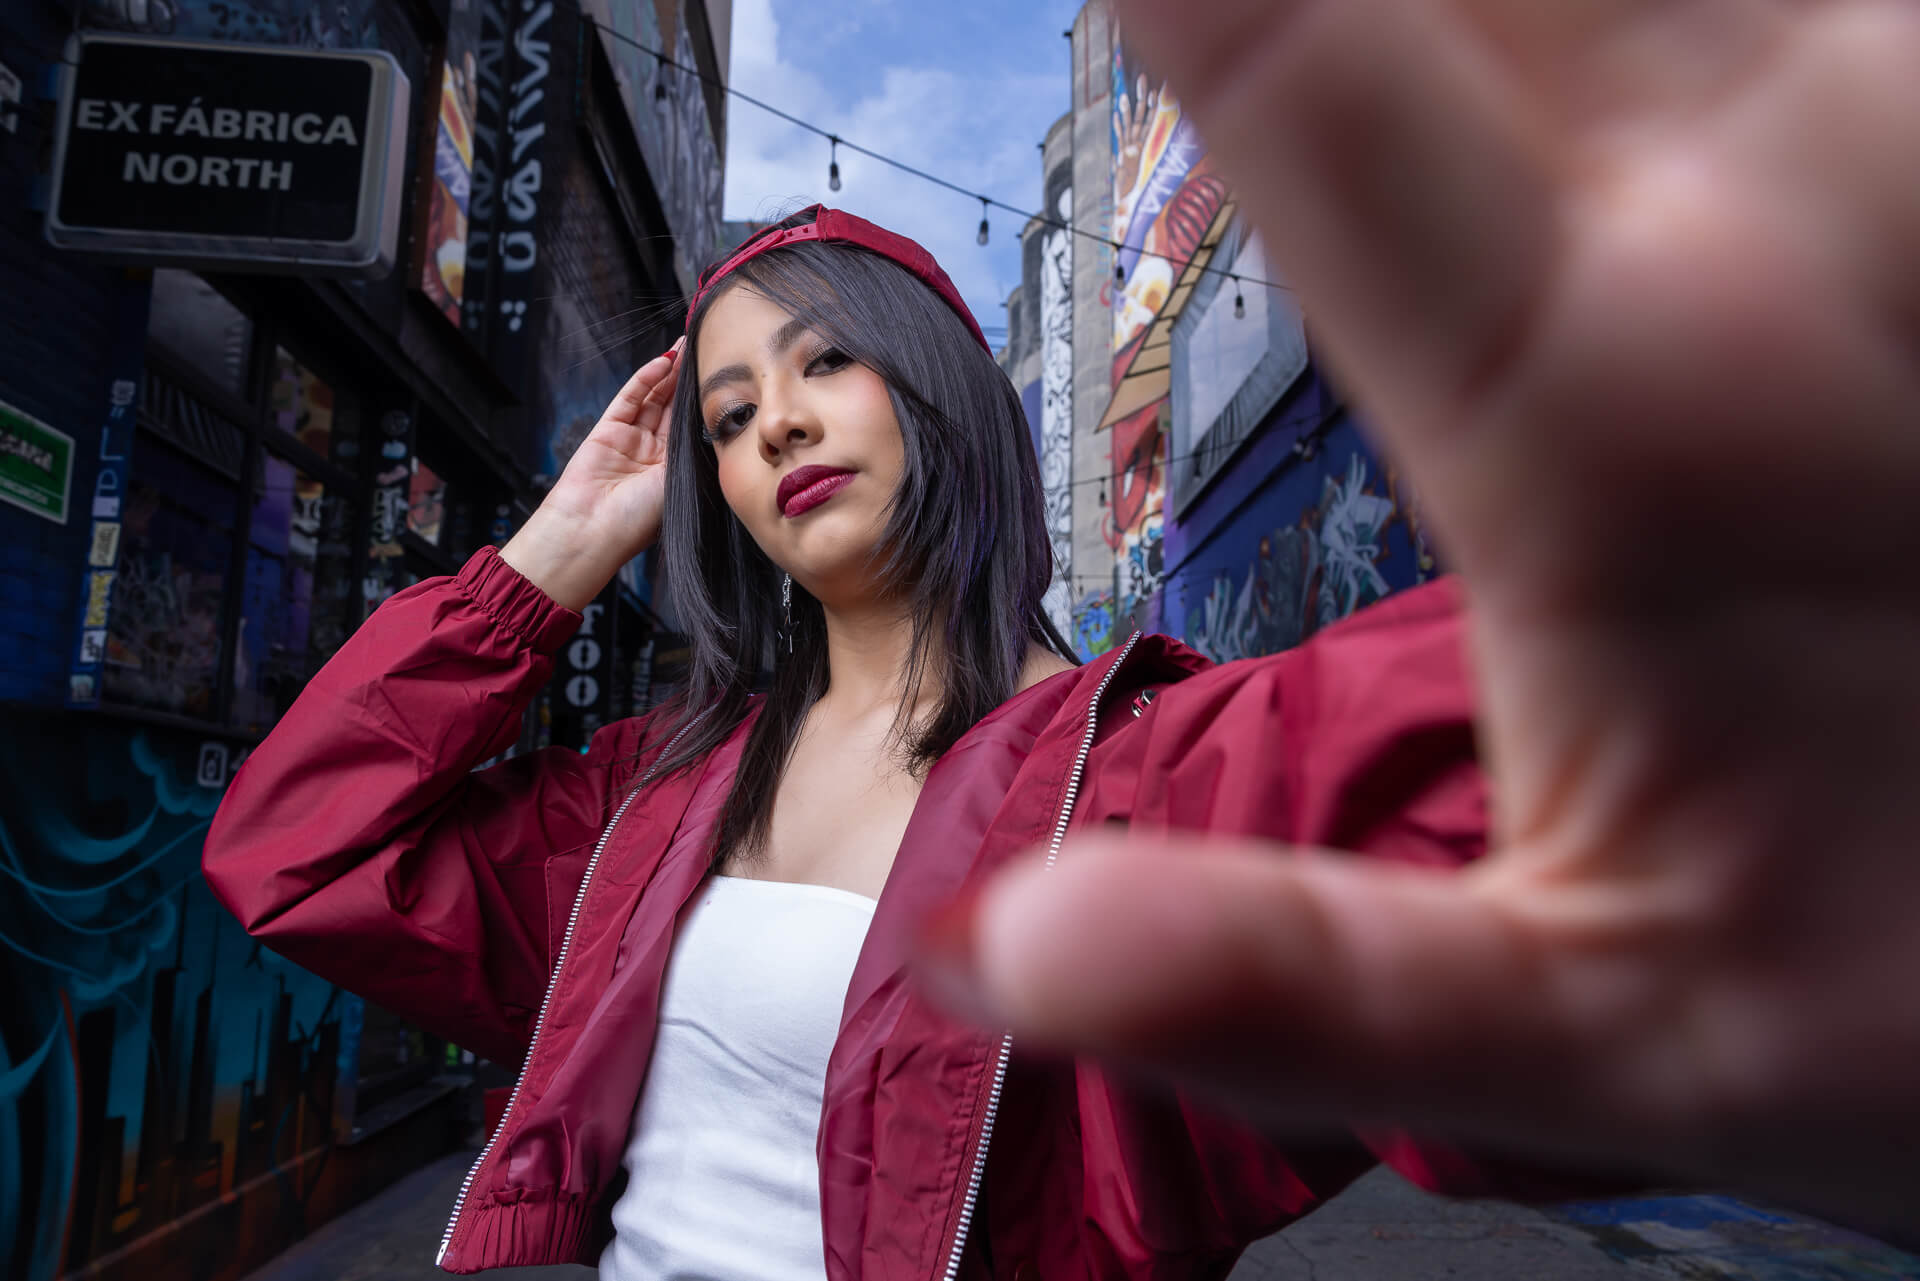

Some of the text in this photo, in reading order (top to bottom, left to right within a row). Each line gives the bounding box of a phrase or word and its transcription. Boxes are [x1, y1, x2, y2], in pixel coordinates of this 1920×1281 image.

[77, 97, 358, 146] EX FÁBRICA
[124, 152, 293, 191] NORTH
